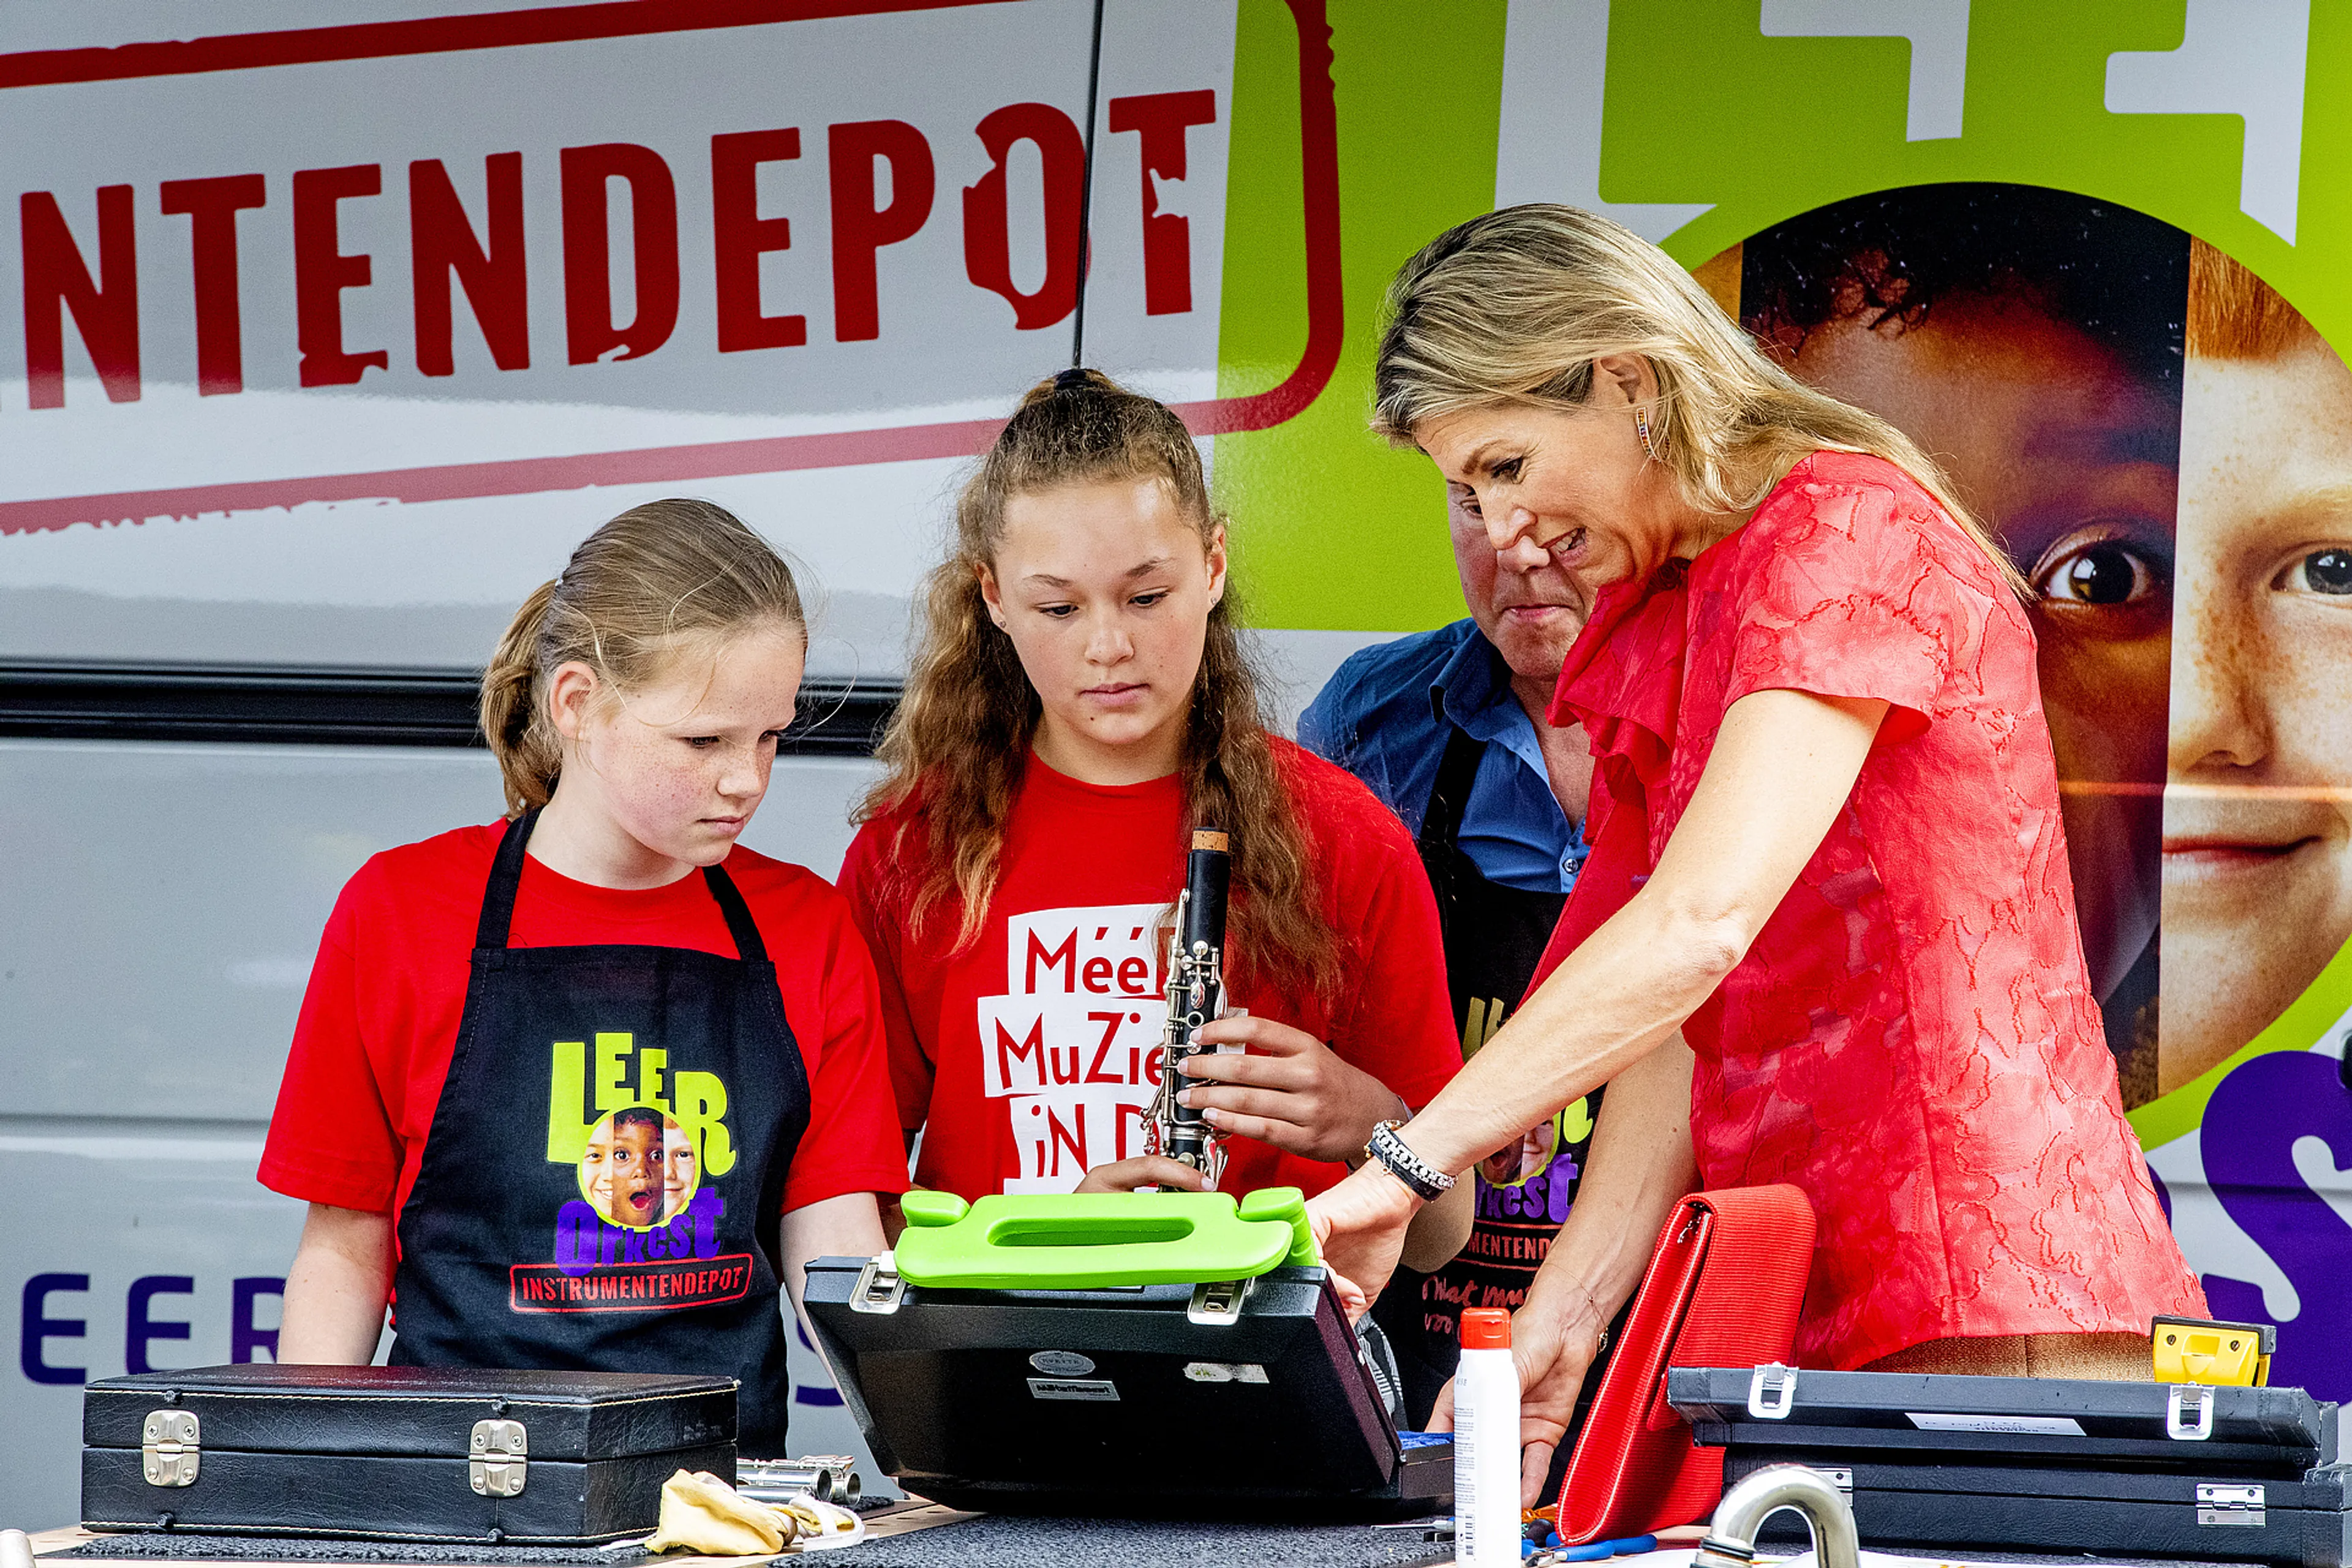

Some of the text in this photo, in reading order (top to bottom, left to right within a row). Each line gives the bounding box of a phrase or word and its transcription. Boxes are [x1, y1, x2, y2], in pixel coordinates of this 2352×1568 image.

[20, 89, 1216, 410] NTENDEPOT
[995, 1012, 1165, 1090] MuZie
[547, 1032, 737, 1177] LEER
[555, 1187, 724, 1277] Orkest
[1468, 1231, 1551, 1261] MENTEND
[522, 1266, 744, 1302] INSTRUMENTENDEPOT
